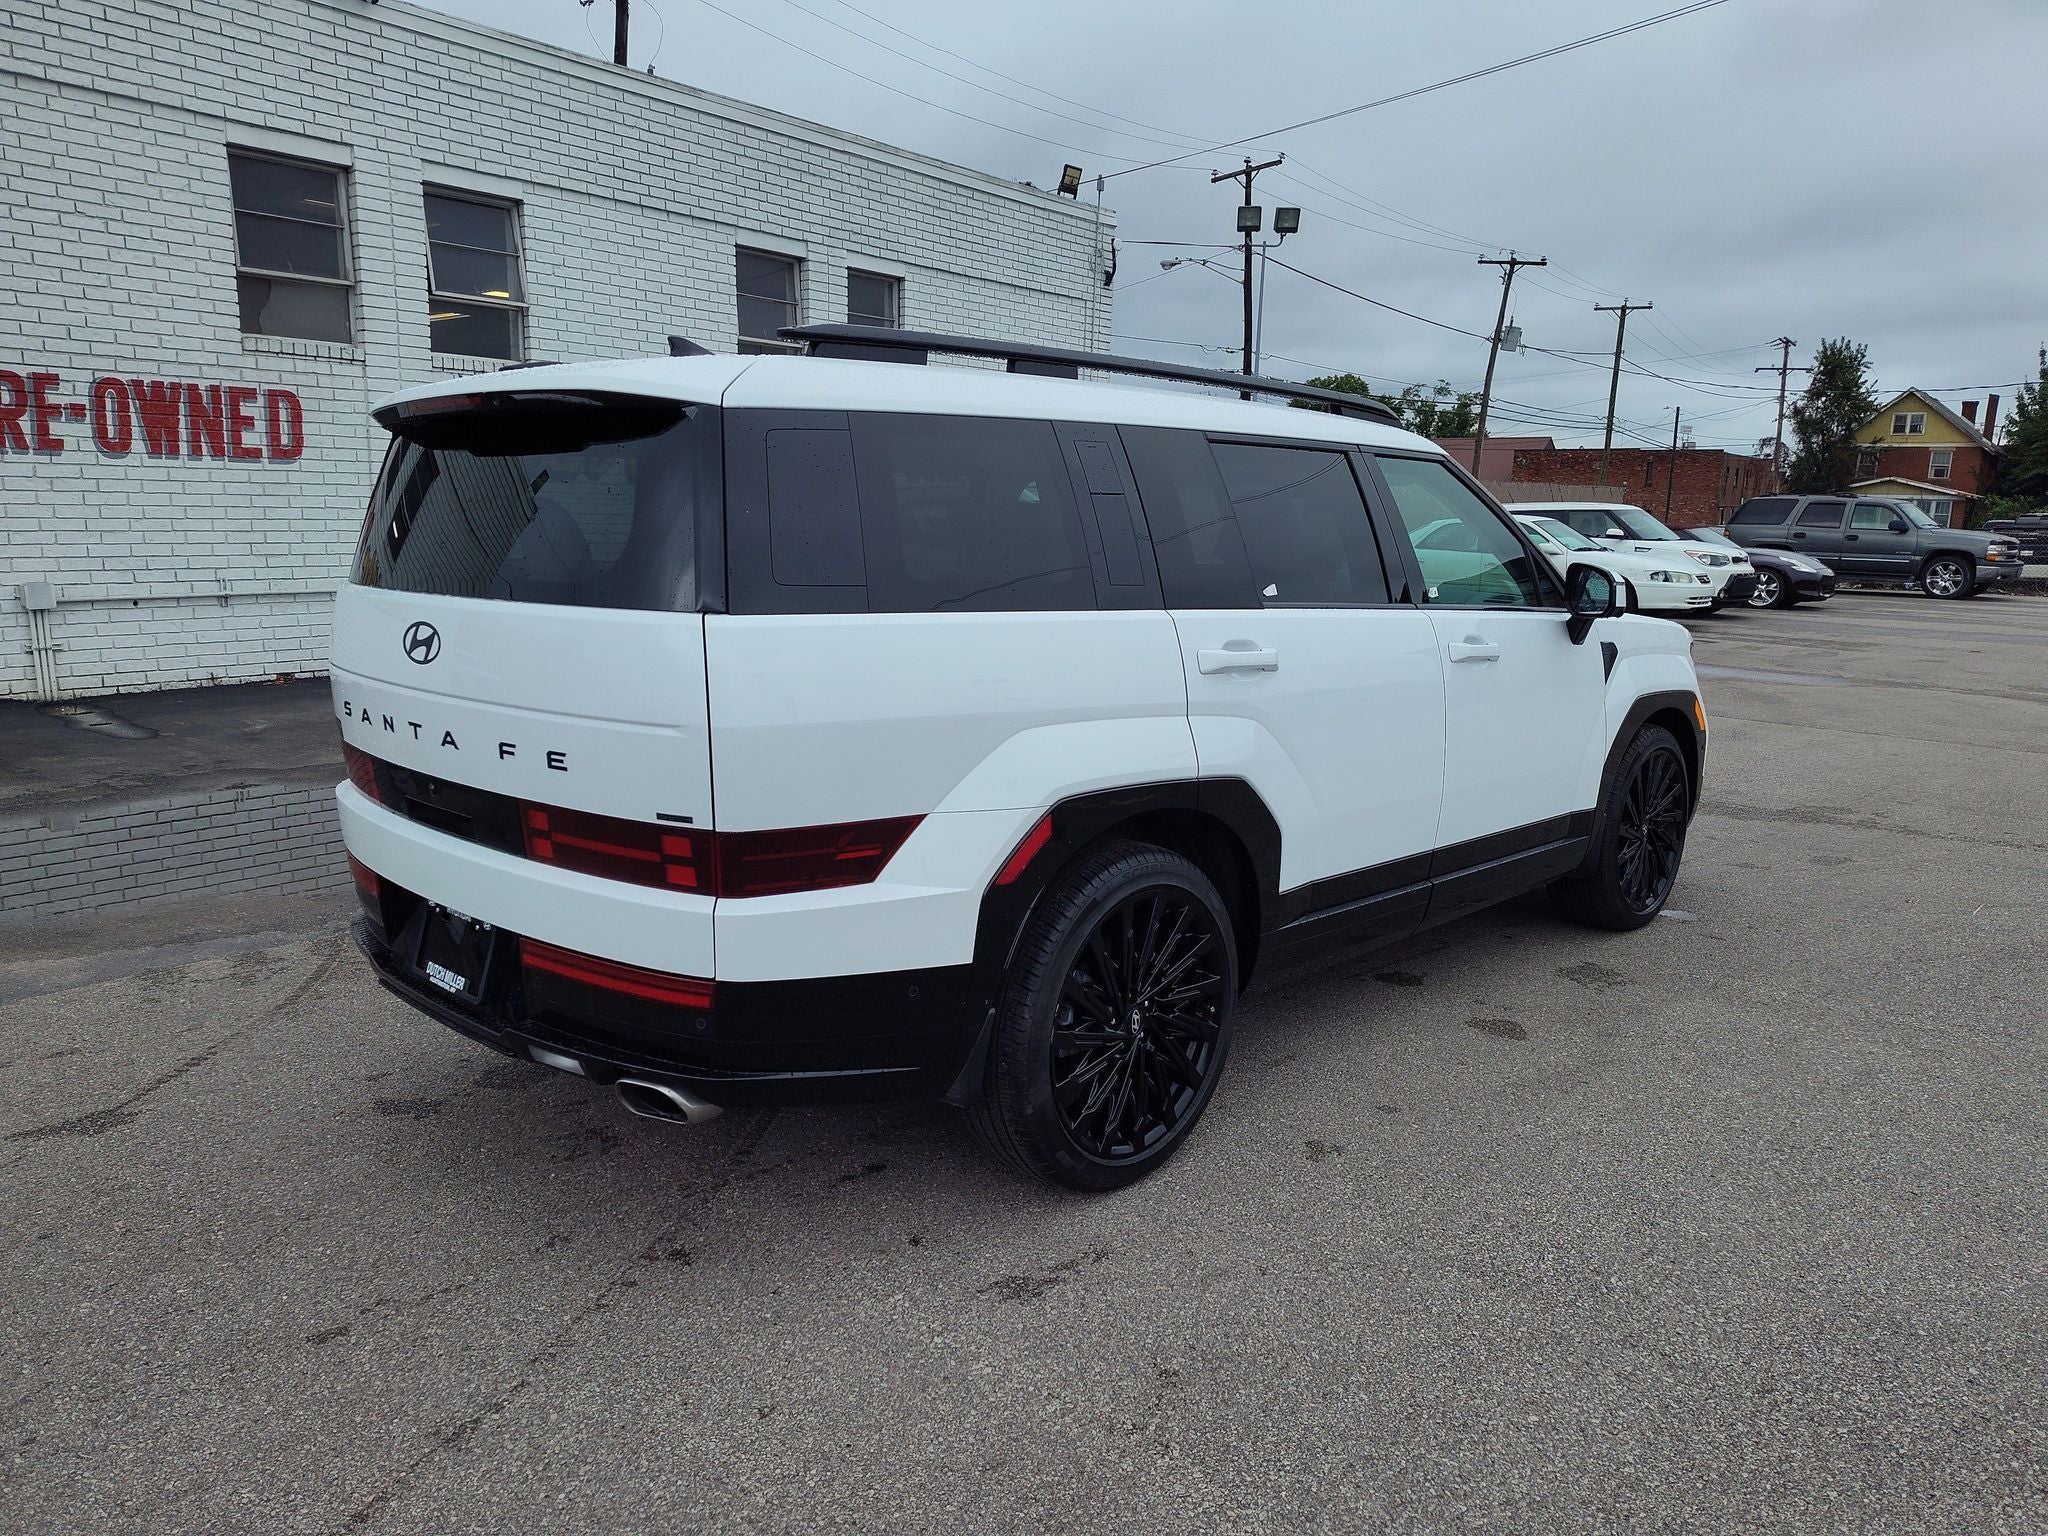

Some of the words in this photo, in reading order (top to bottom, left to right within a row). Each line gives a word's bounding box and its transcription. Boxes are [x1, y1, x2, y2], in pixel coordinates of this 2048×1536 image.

[0, 369, 304, 462] RE-OWNED
[343, 700, 460, 751] SANTA
[498, 741, 569, 772] FE
